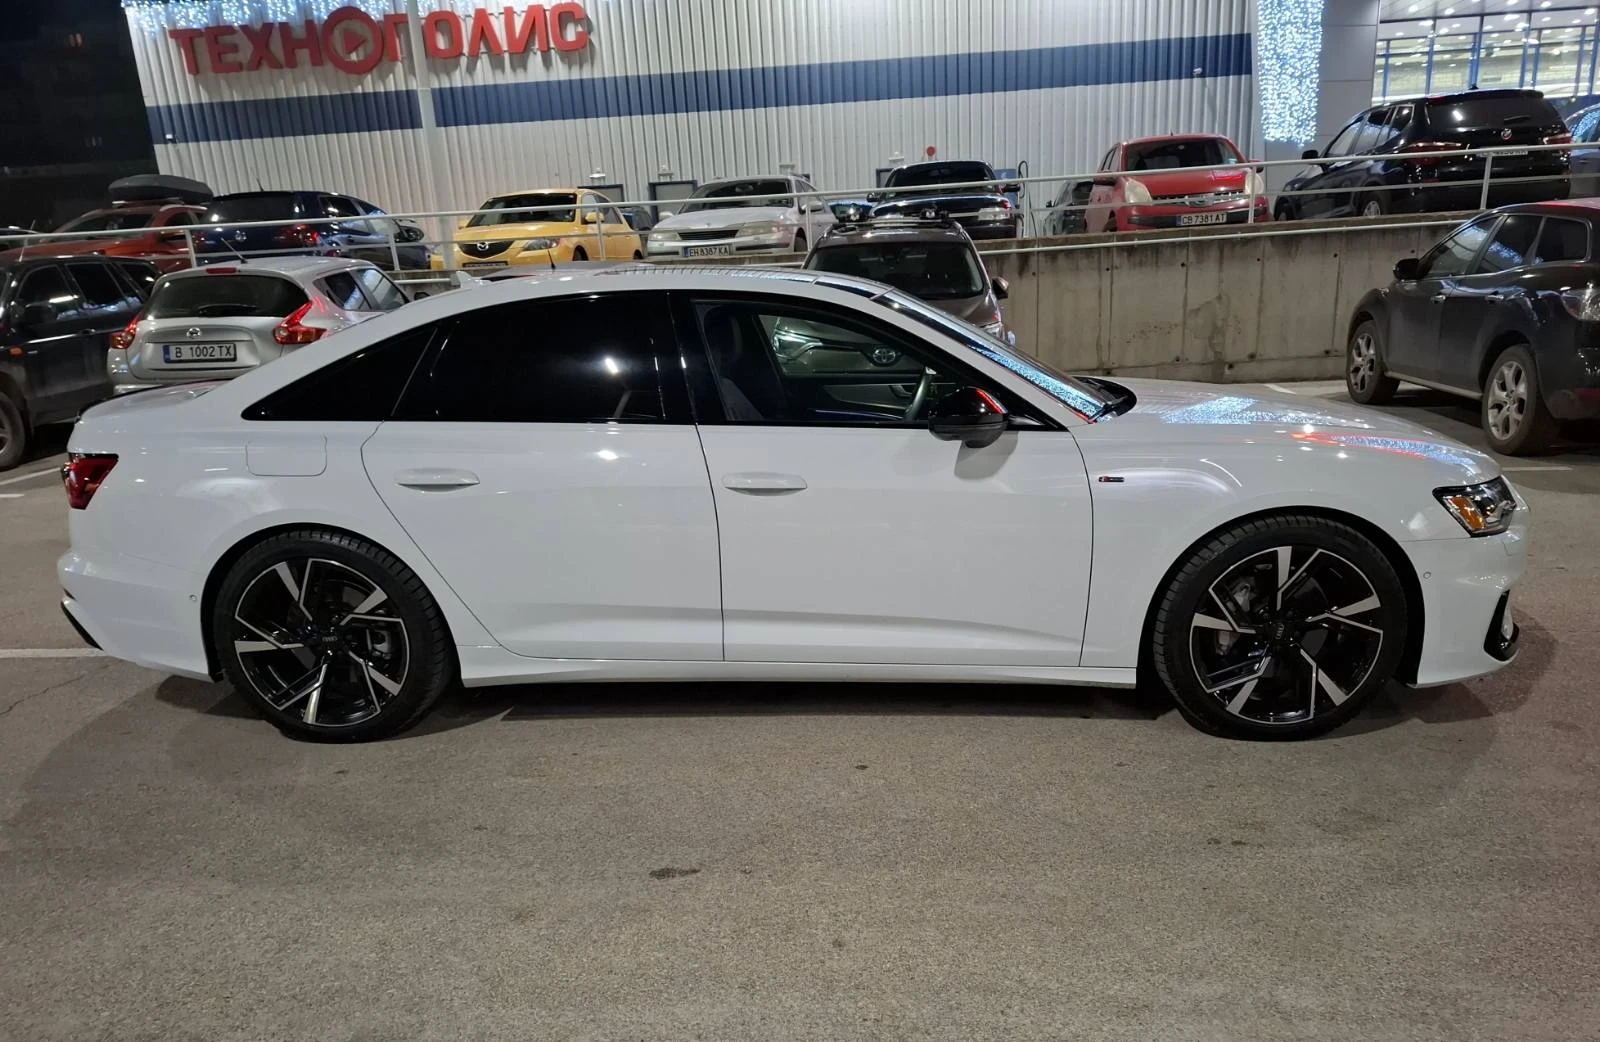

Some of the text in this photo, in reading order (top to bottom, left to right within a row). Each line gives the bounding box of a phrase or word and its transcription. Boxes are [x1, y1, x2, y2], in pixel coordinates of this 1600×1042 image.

[175, 345, 232, 358] B 1002 TX
